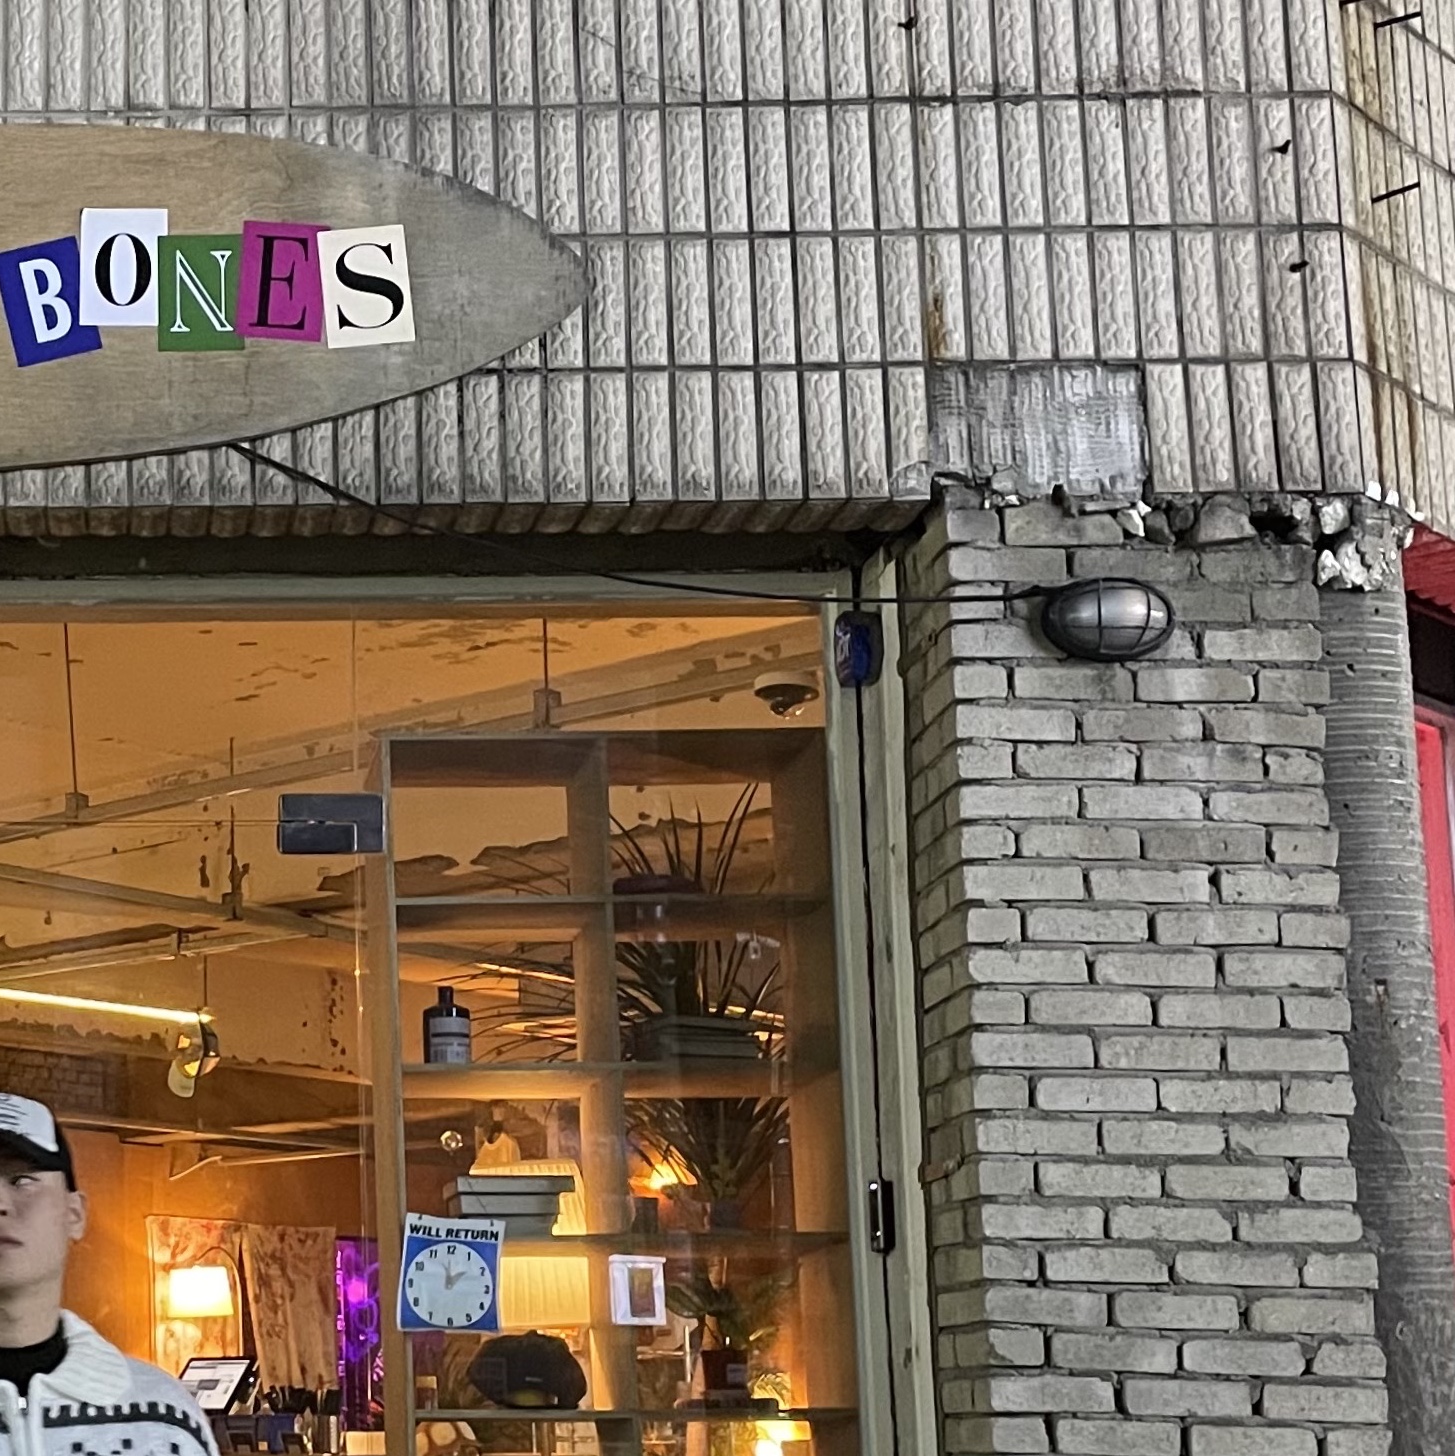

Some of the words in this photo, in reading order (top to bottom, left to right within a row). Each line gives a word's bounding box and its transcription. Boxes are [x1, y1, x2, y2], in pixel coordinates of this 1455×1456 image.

[19, 232, 404, 345] BONES
[409, 1223, 442, 1238] WILL
[445, 1228, 499, 1241] RETURN
[429, 1249, 438, 1259] 11
[447, 1245, 456, 1255] 12
[467, 1251, 471, 1261] 1
[415, 1261, 424, 1271] 10
